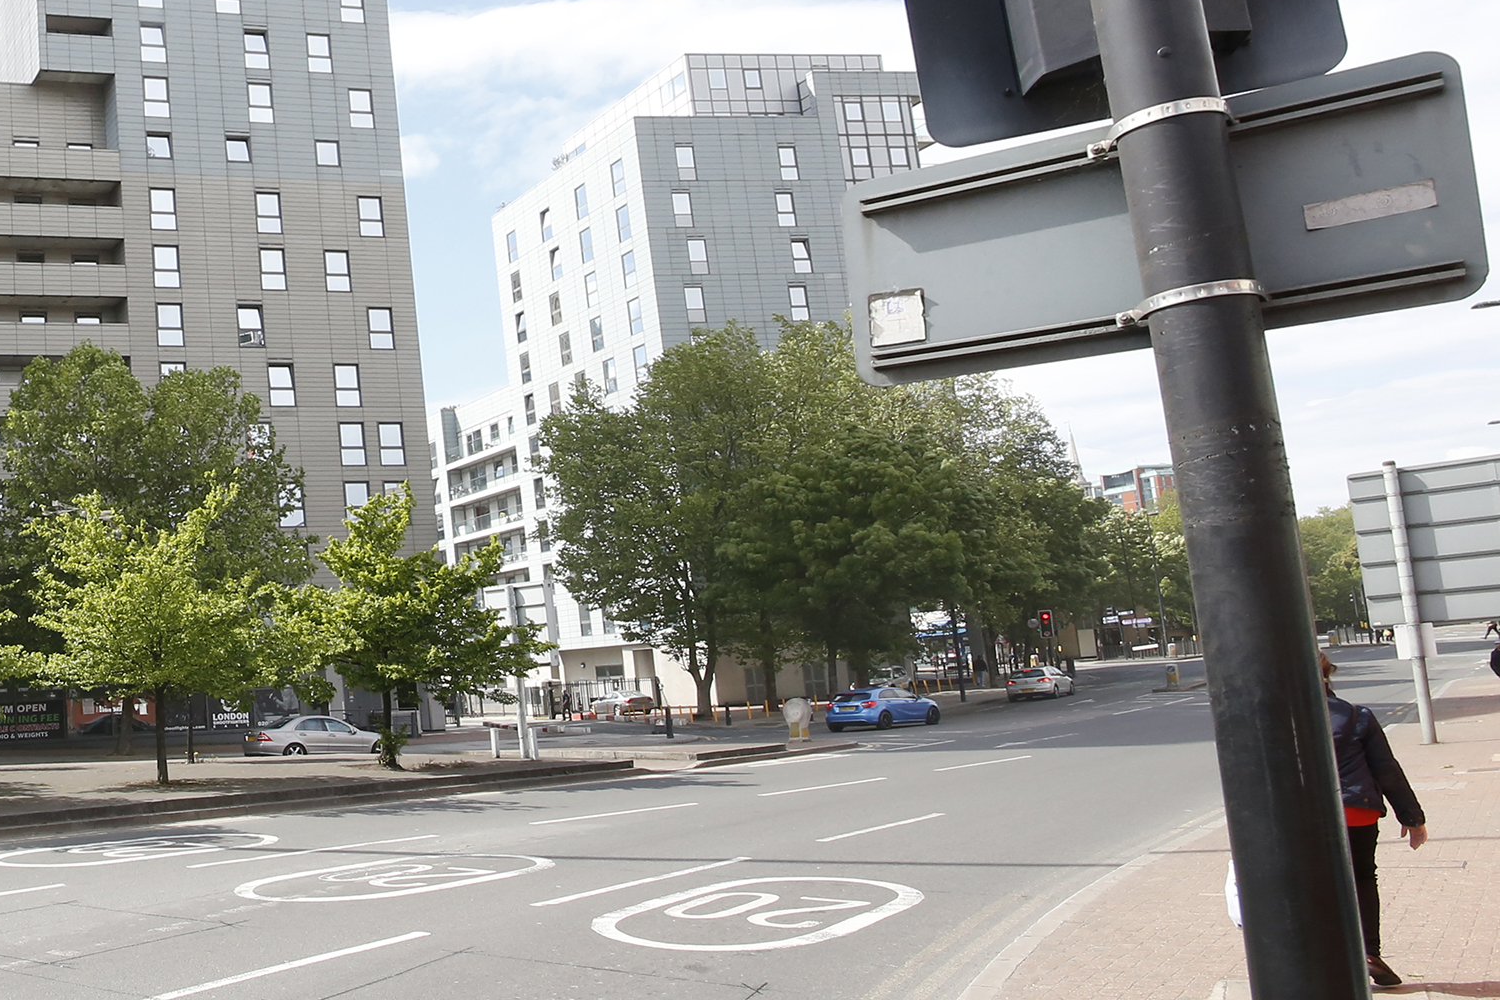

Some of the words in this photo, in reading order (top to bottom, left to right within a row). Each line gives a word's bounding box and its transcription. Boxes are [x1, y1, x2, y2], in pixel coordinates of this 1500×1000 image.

[17, 703, 47, 713] OPEN
[40, 713, 60, 722] FEE
[212, 712, 250, 721] LONDON
[17, 731, 49, 739] WEIGHTS
[317, 864, 497, 888] 20
[663, 891, 872, 929] 20
